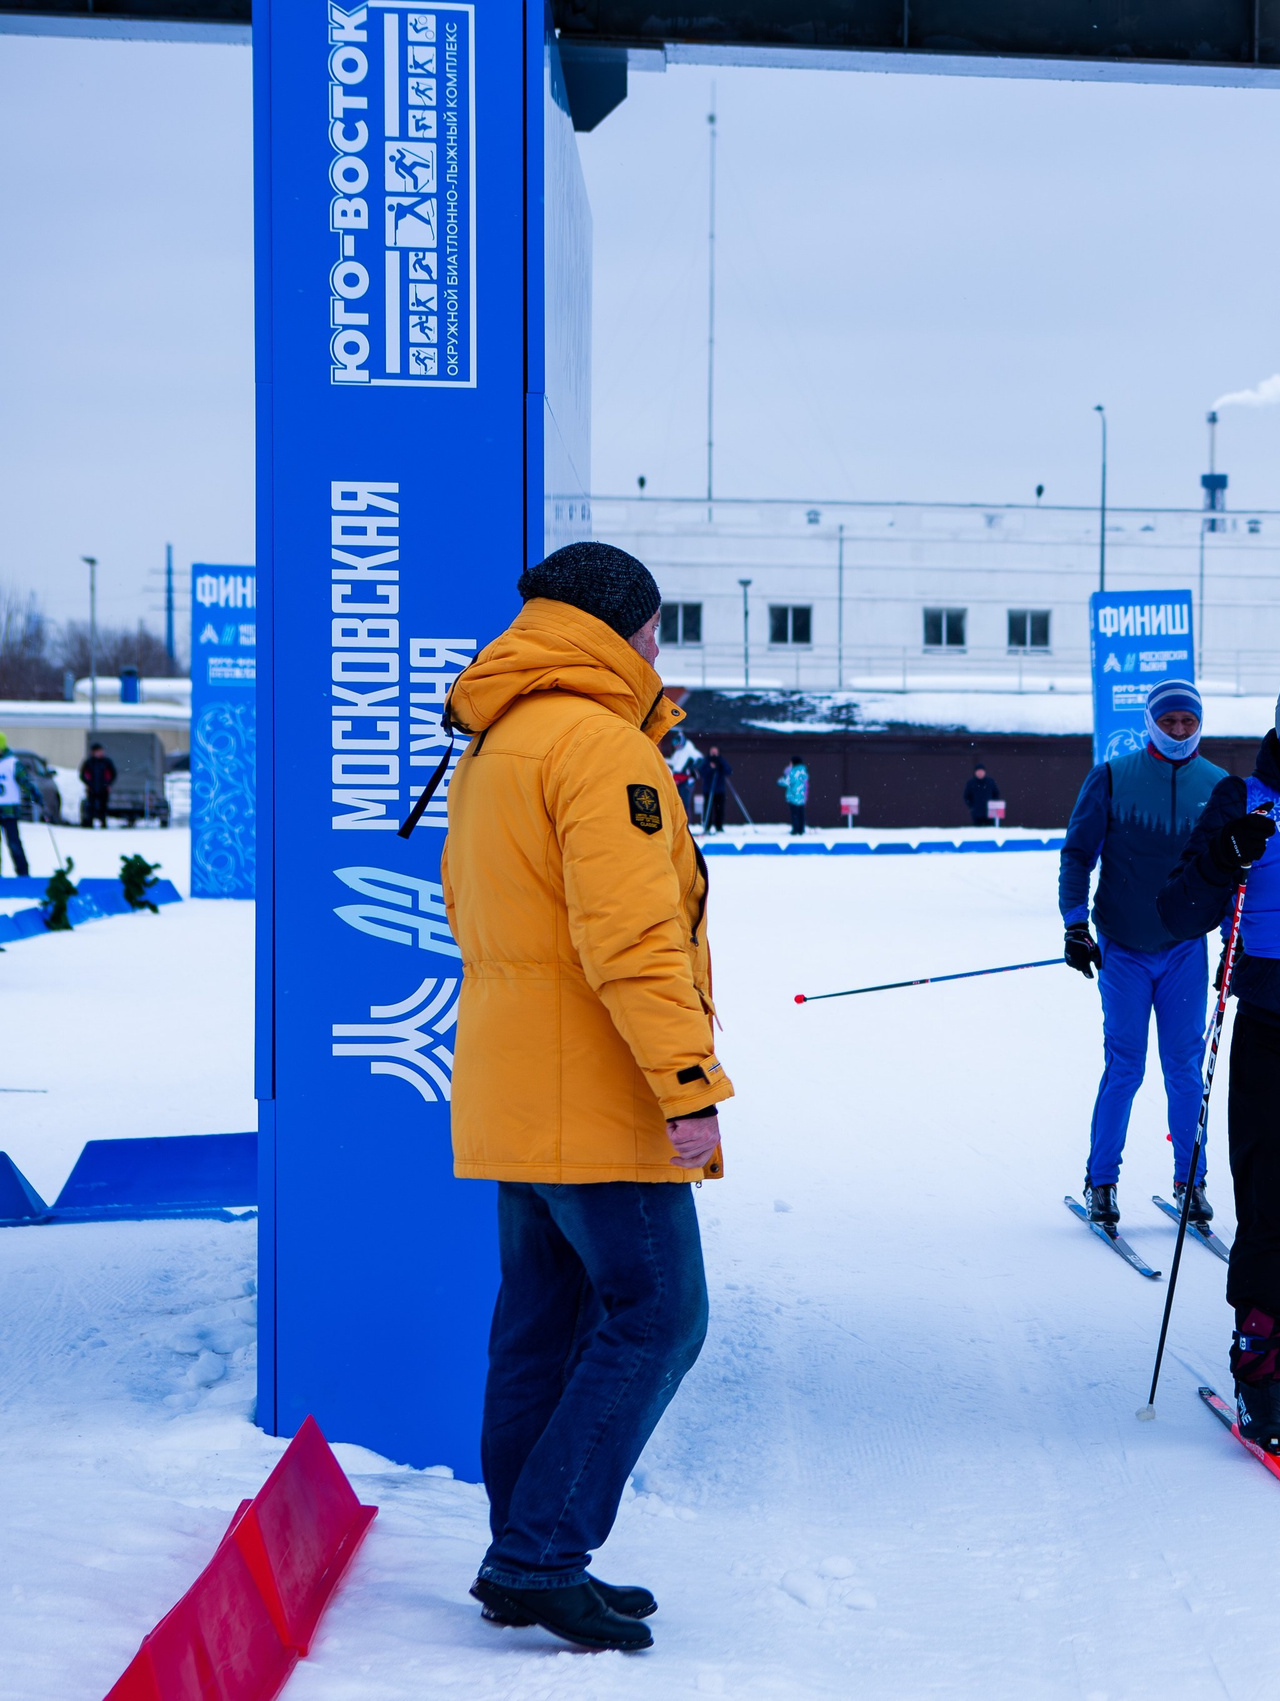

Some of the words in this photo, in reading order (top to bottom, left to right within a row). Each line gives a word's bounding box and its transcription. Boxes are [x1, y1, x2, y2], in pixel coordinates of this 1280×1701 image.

[445, 22, 458, 108] КОМПЛЕКС
[328, 1, 371, 385] ЮГО-ВОСТОК
[442, 111, 458, 285] БИАТЛОННО-ЛЫЖНЫЙ
[443, 289, 459, 376] ОКРУЖНОЙ
[196, 574, 256, 608] ФИН
[1098, 603, 1189, 637] ФИНИШ
[331, 481, 399, 830] МОСКОВСКАЯ
